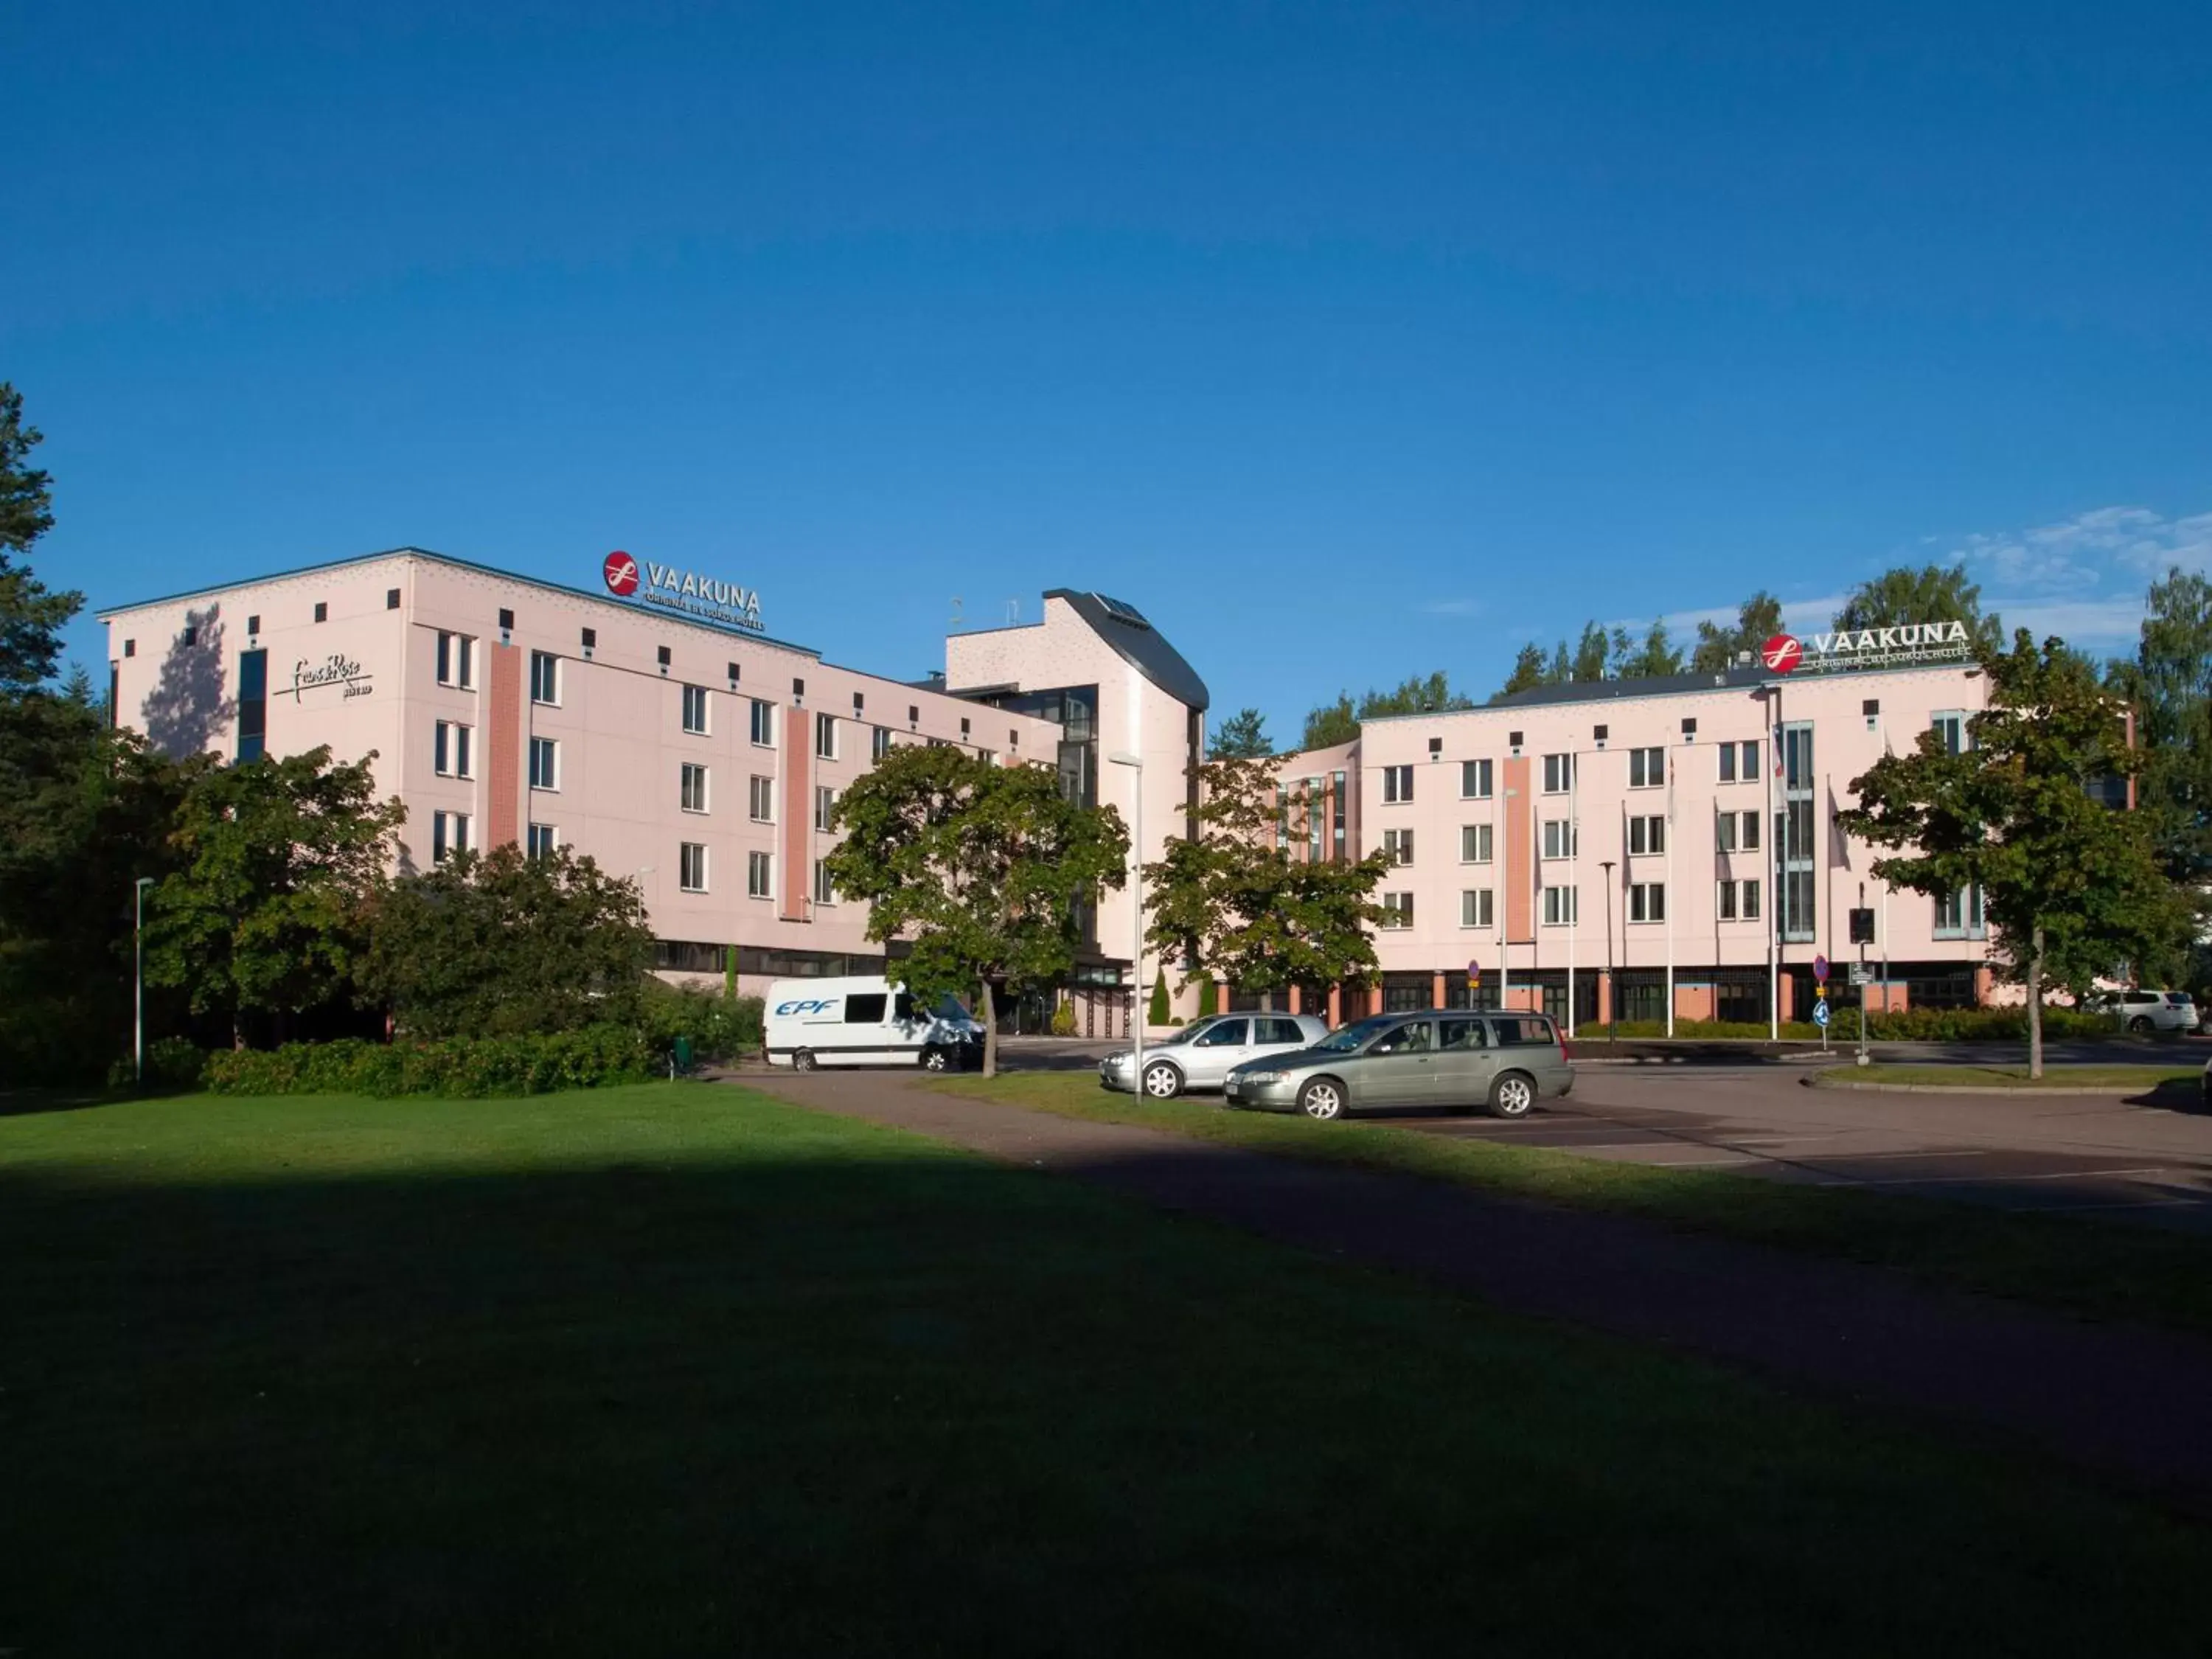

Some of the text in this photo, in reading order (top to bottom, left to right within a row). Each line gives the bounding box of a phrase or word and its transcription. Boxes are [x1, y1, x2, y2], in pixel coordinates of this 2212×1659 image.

[647, 561, 760, 613] VAAKUNA
[1815, 620, 1969, 653] VAAKUNA
[776, 999, 840, 1015] EPF
